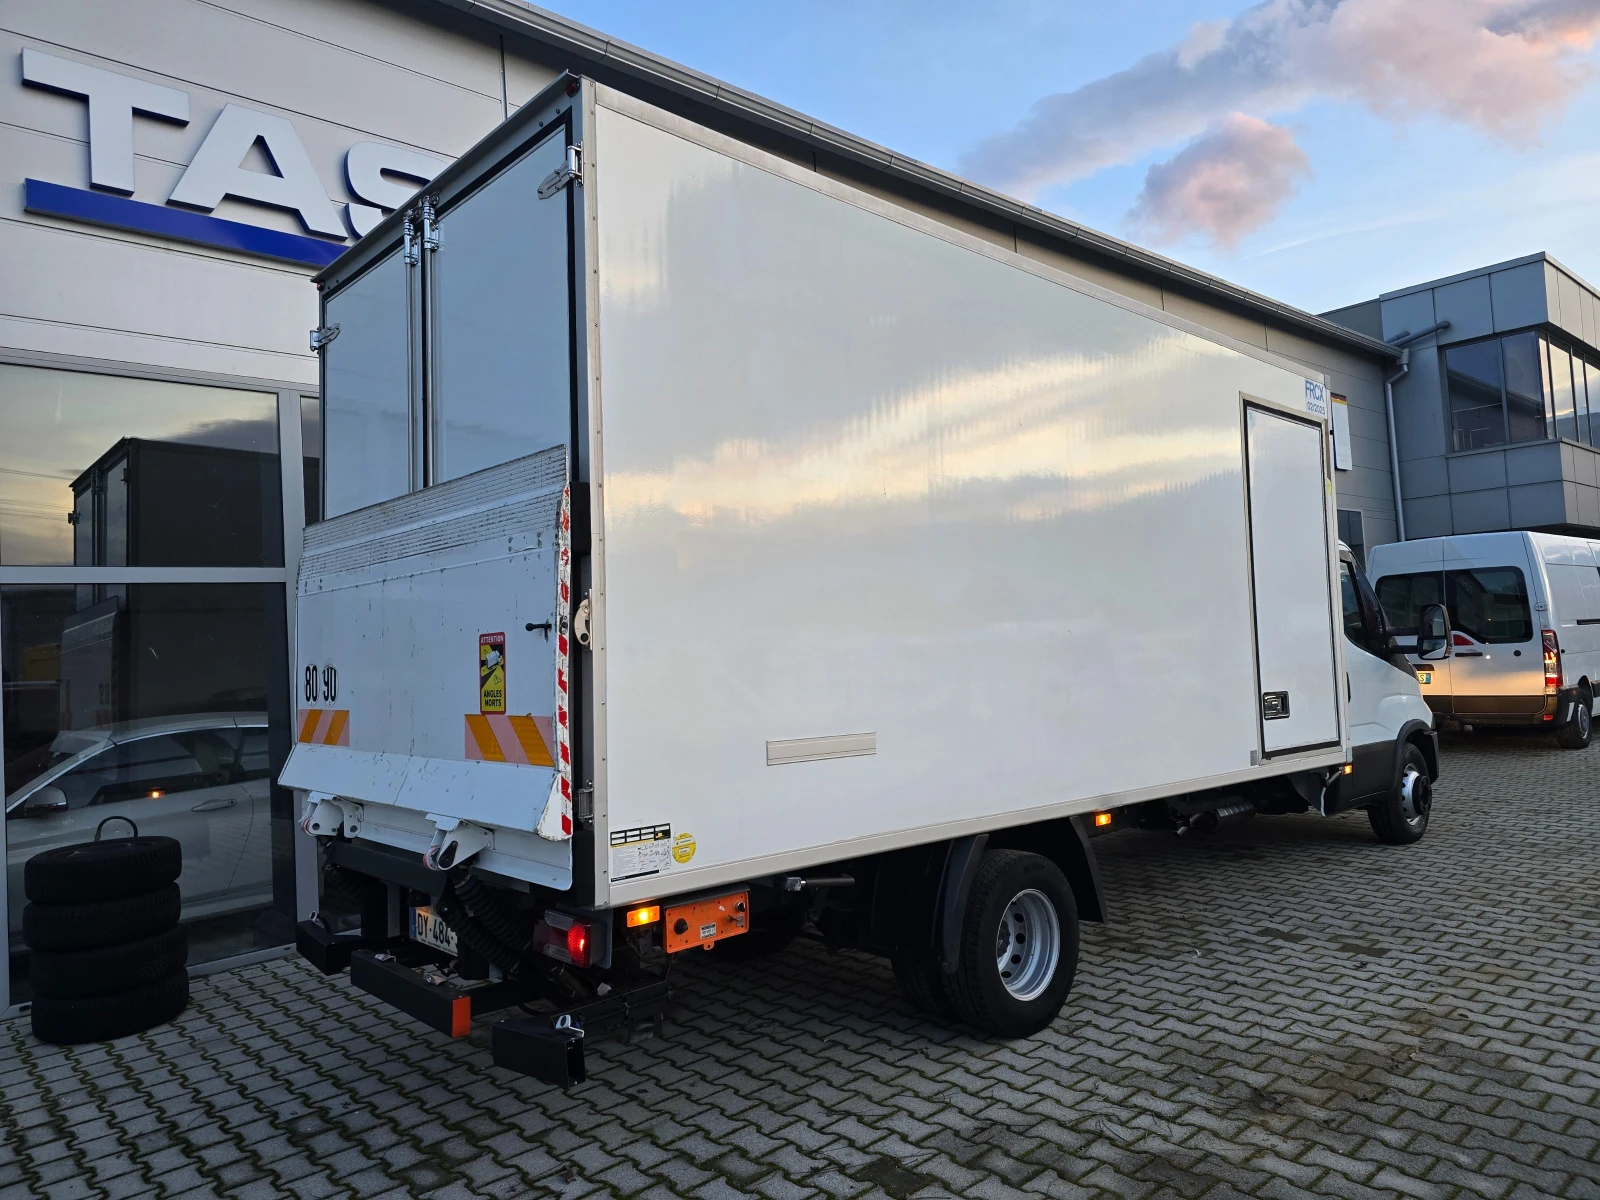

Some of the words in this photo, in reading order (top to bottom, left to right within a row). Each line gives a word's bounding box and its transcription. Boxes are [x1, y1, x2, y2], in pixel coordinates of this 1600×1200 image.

[1305, 380, 1325, 402] FRCX
[480, 635, 504, 644] ATTENTION
[305, 664, 318, 702] 80
[323, 666, 337, 702] 90
[483, 689, 503, 698] ANGLES
[484, 698, 502, 707] MORTS
[417, 912, 458, 950] DY-484-
